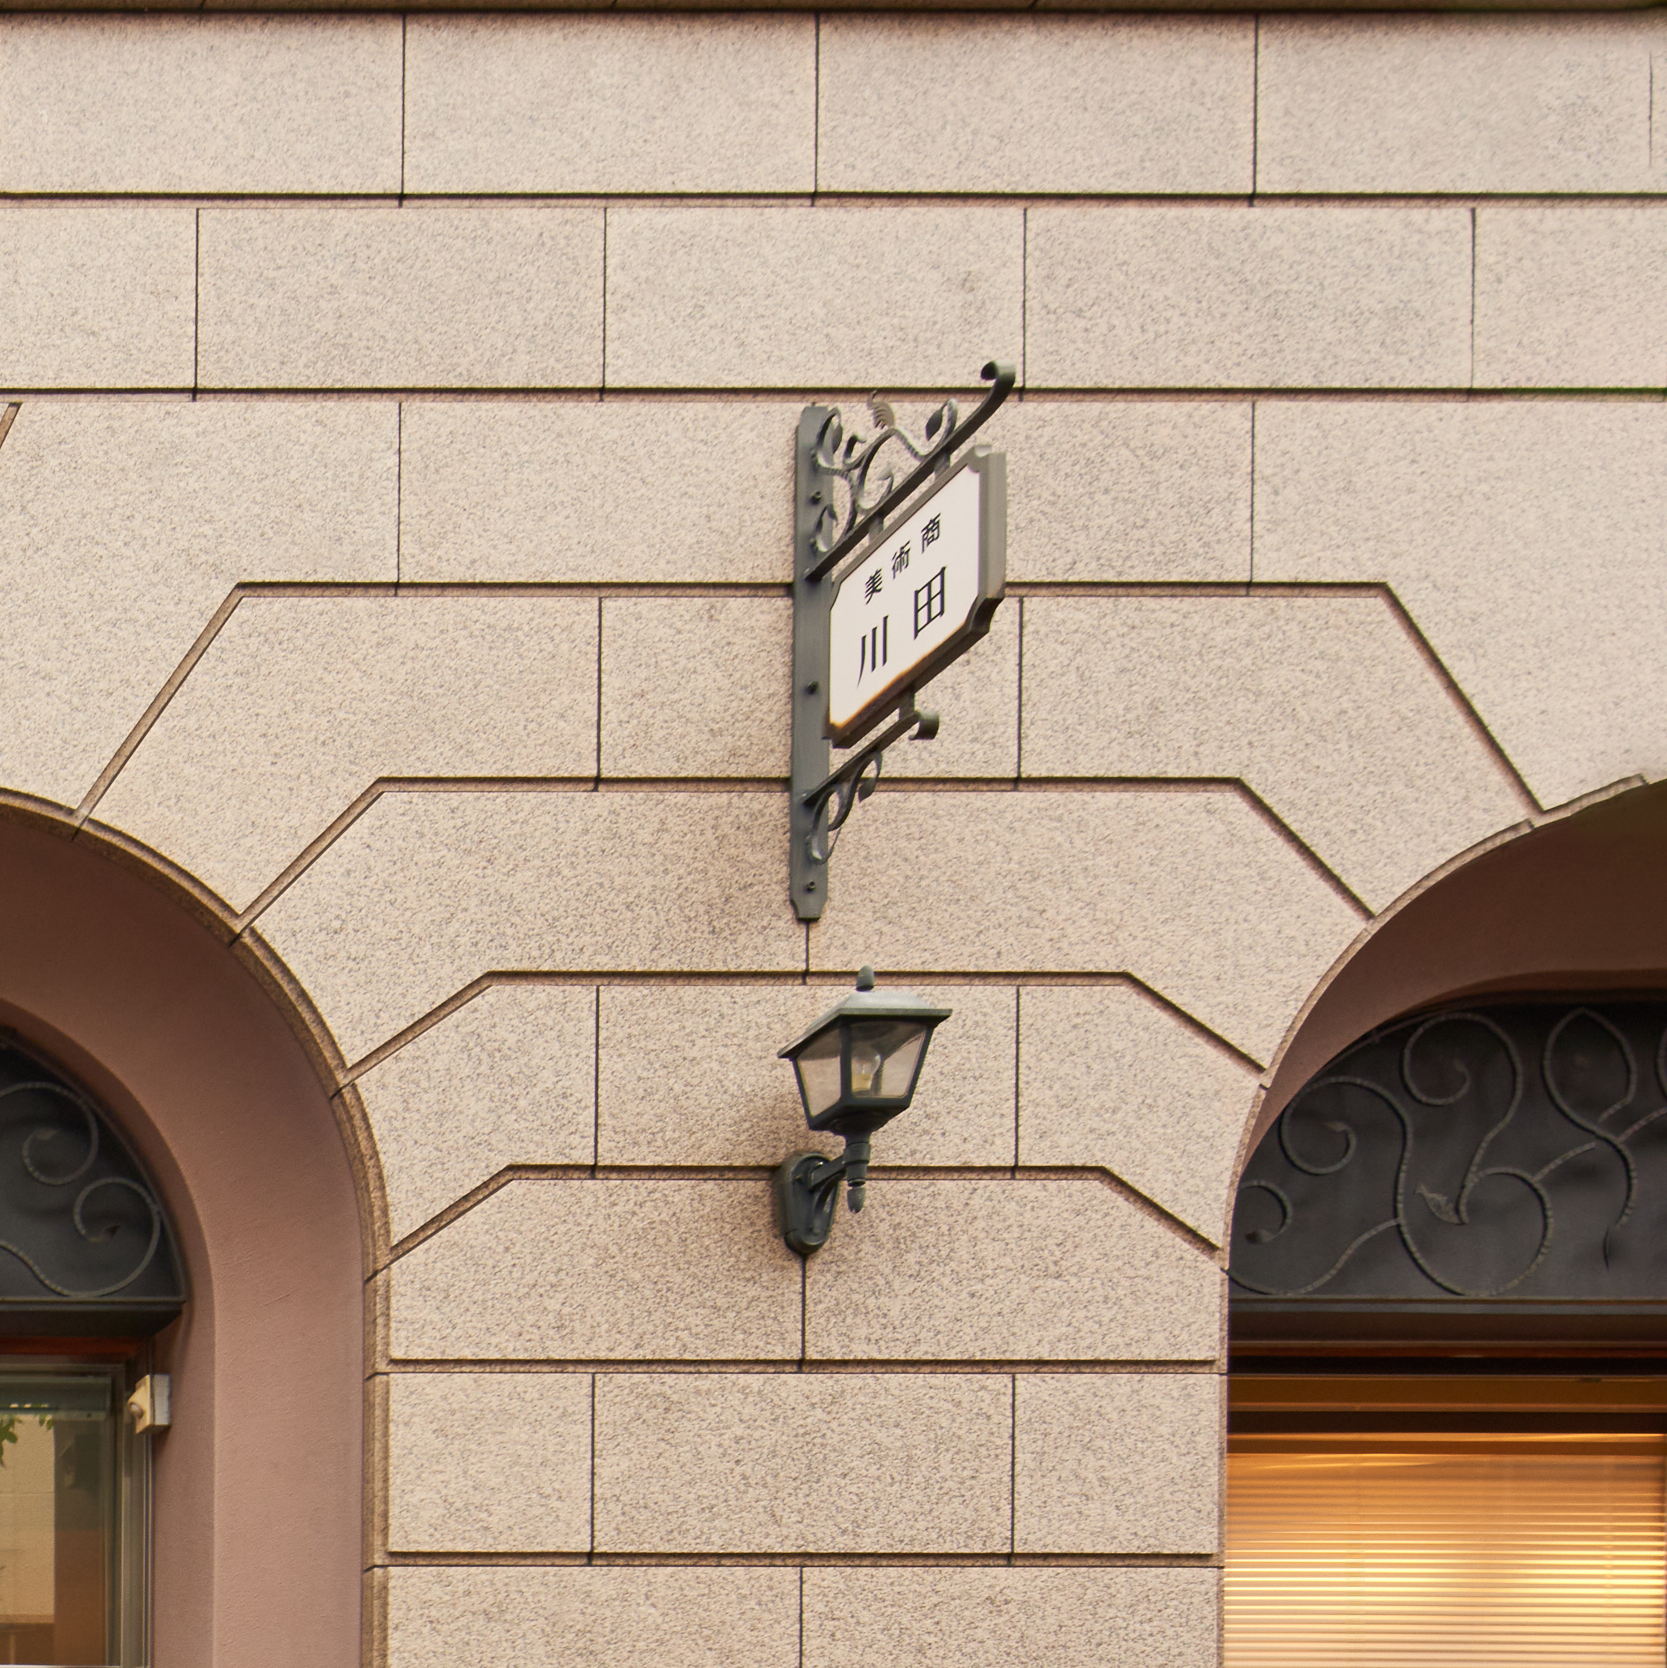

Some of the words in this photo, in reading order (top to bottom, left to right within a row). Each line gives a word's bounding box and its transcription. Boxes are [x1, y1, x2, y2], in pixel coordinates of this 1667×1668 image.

[865, 512, 941, 605] 美術商
[857, 566, 946, 687] 川田
